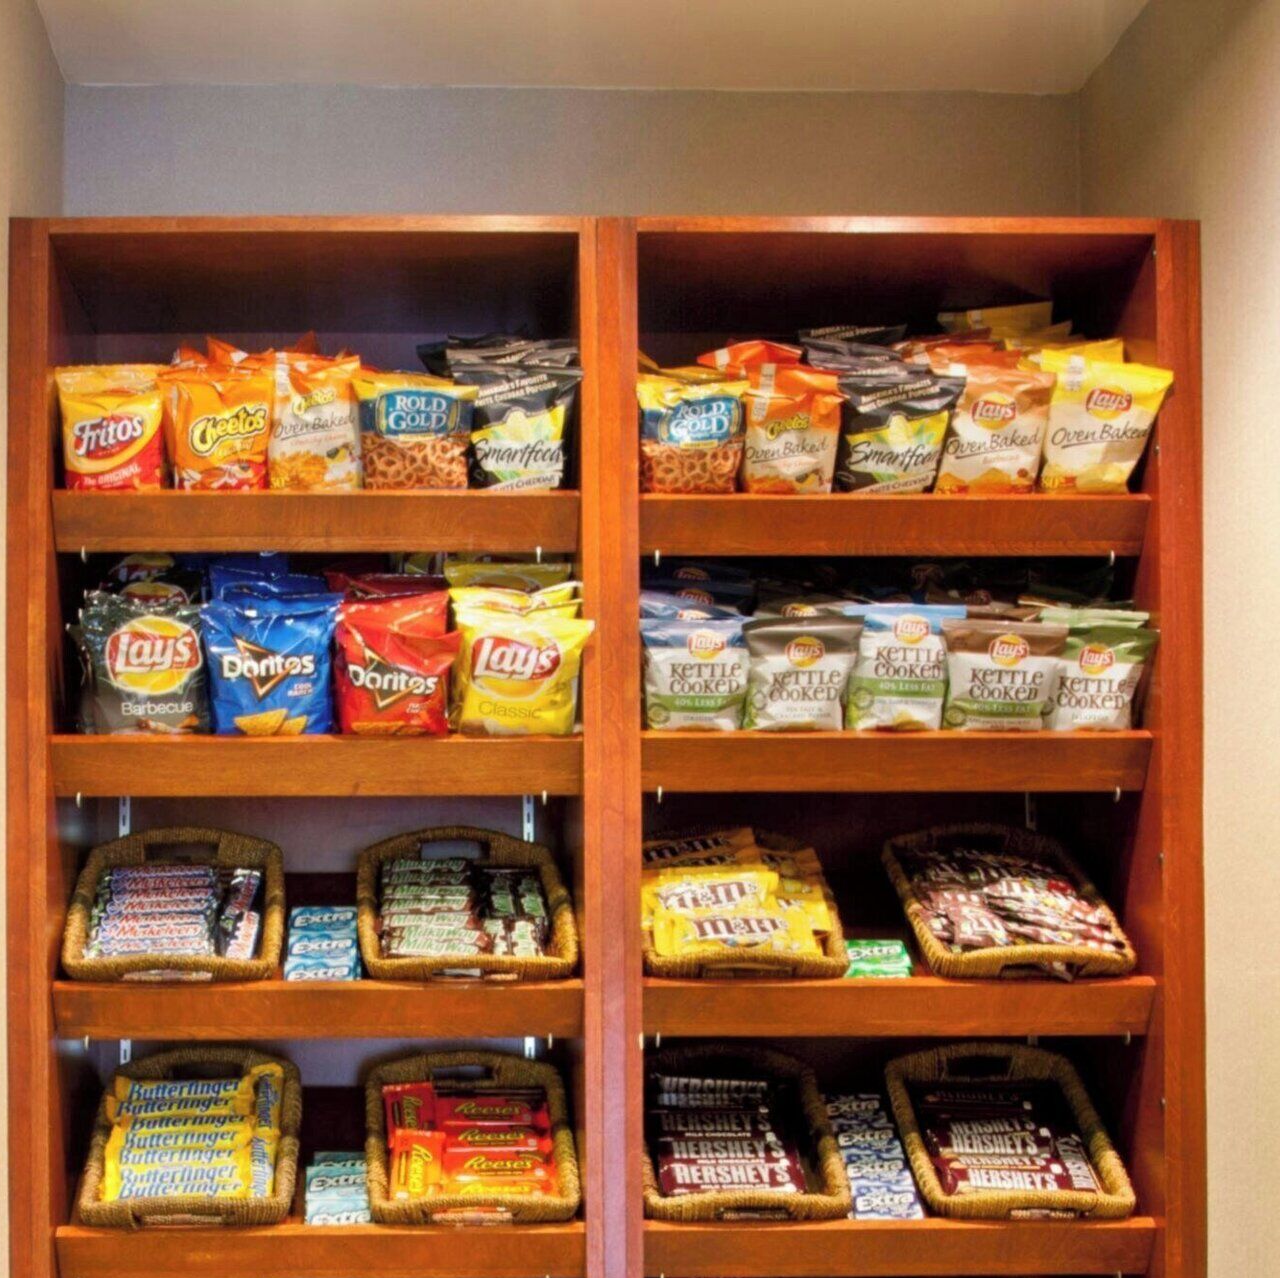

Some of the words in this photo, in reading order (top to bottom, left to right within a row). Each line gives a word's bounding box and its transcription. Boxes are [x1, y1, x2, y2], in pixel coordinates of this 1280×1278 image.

[394, 394, 448, 414] ROLD
[191, 404, 267, 455] Cheetos
[387, 410, 449, 431] GOLD
[73, 415, 145, 456] Fritos
[222, 652, 316, 680] Doritos
[347, 663, 440, 695] Doritos
[120, 700, 194, 717] Barbecue
[478, 700, 542, 720] Classic
[294, 911, 354, 928] Extra
[291, 938, 353, 955] Extra
[128, 1079, 241, 1101] Butterfinger
[116, 1096, 233, 1117] Butterfinger
[124, 1130, 238, 1150] Butterfinger
[836, 1128, 895, 1148] Extra
[952, 1131, 1039, 1156] HERSHEY'S
[672, 1140, 787, 1159] HERSHEY'S
[119, 1165, 238, 1186] Butterfinger
[674, 1164, 792, 1184] HERSHEY'S
[846, 1160, 905, 1179] Extra
[967, 1168, 1060, 1191] HERSHEY'S
[854, 1192, 915, 1212] Extra
